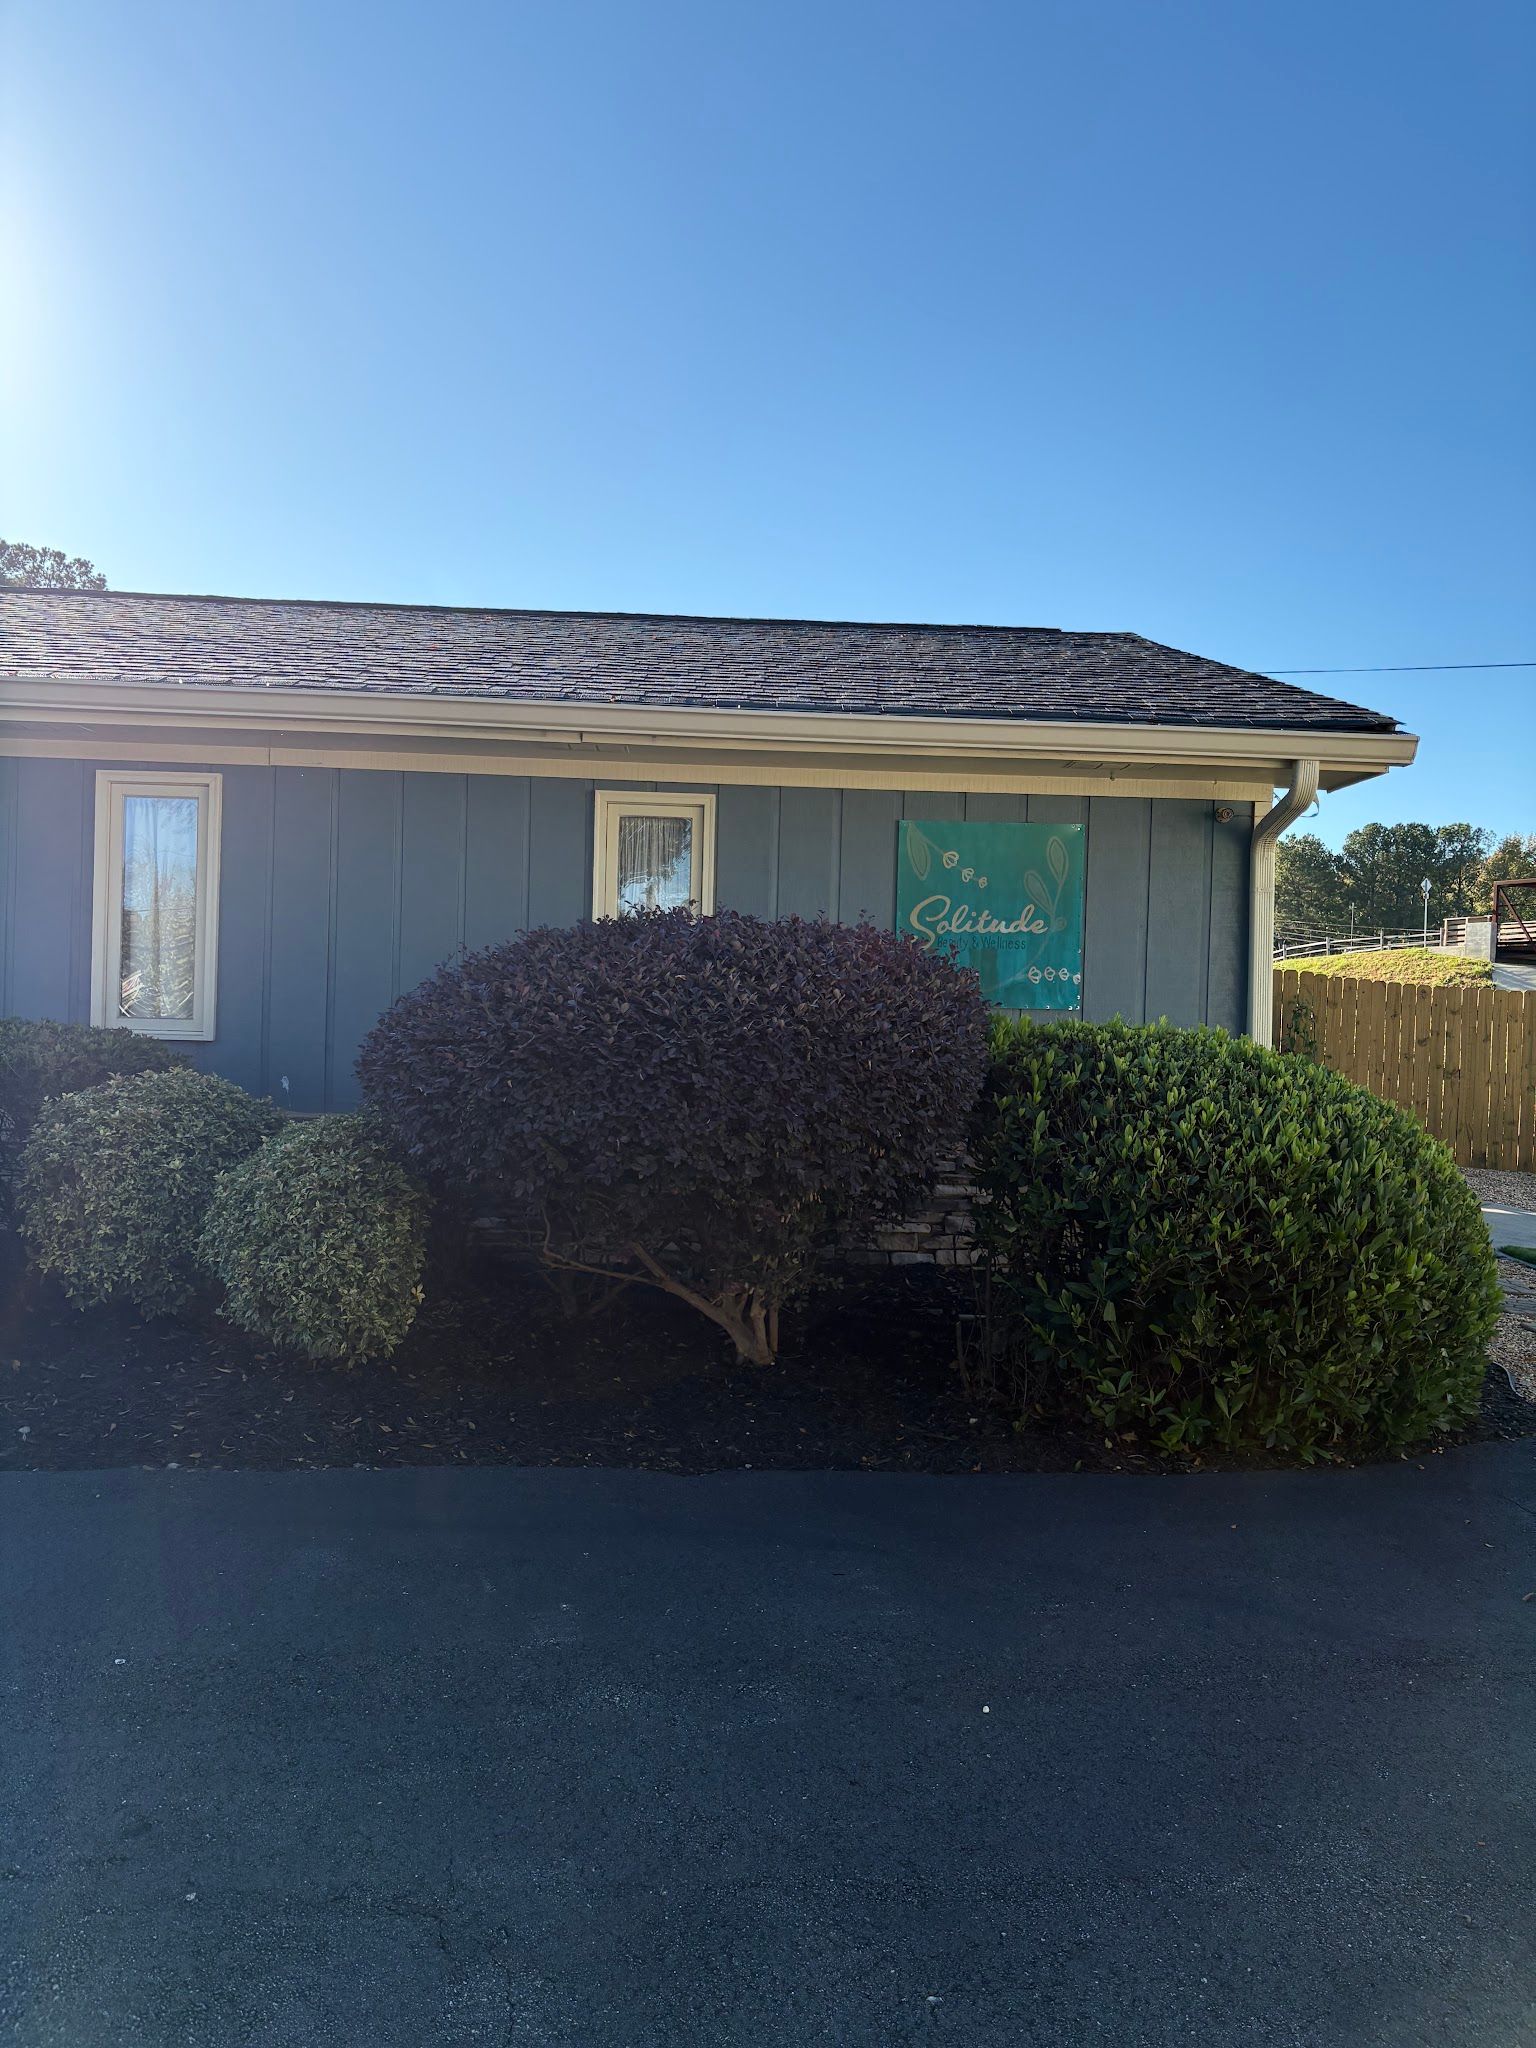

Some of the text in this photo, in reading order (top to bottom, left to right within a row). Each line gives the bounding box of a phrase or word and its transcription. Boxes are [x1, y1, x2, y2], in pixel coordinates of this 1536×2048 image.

[910, 895, 1048, 950] Solitude
[973, 936, 979, 948] &
[981, 936, 1026, 950] Wellness
